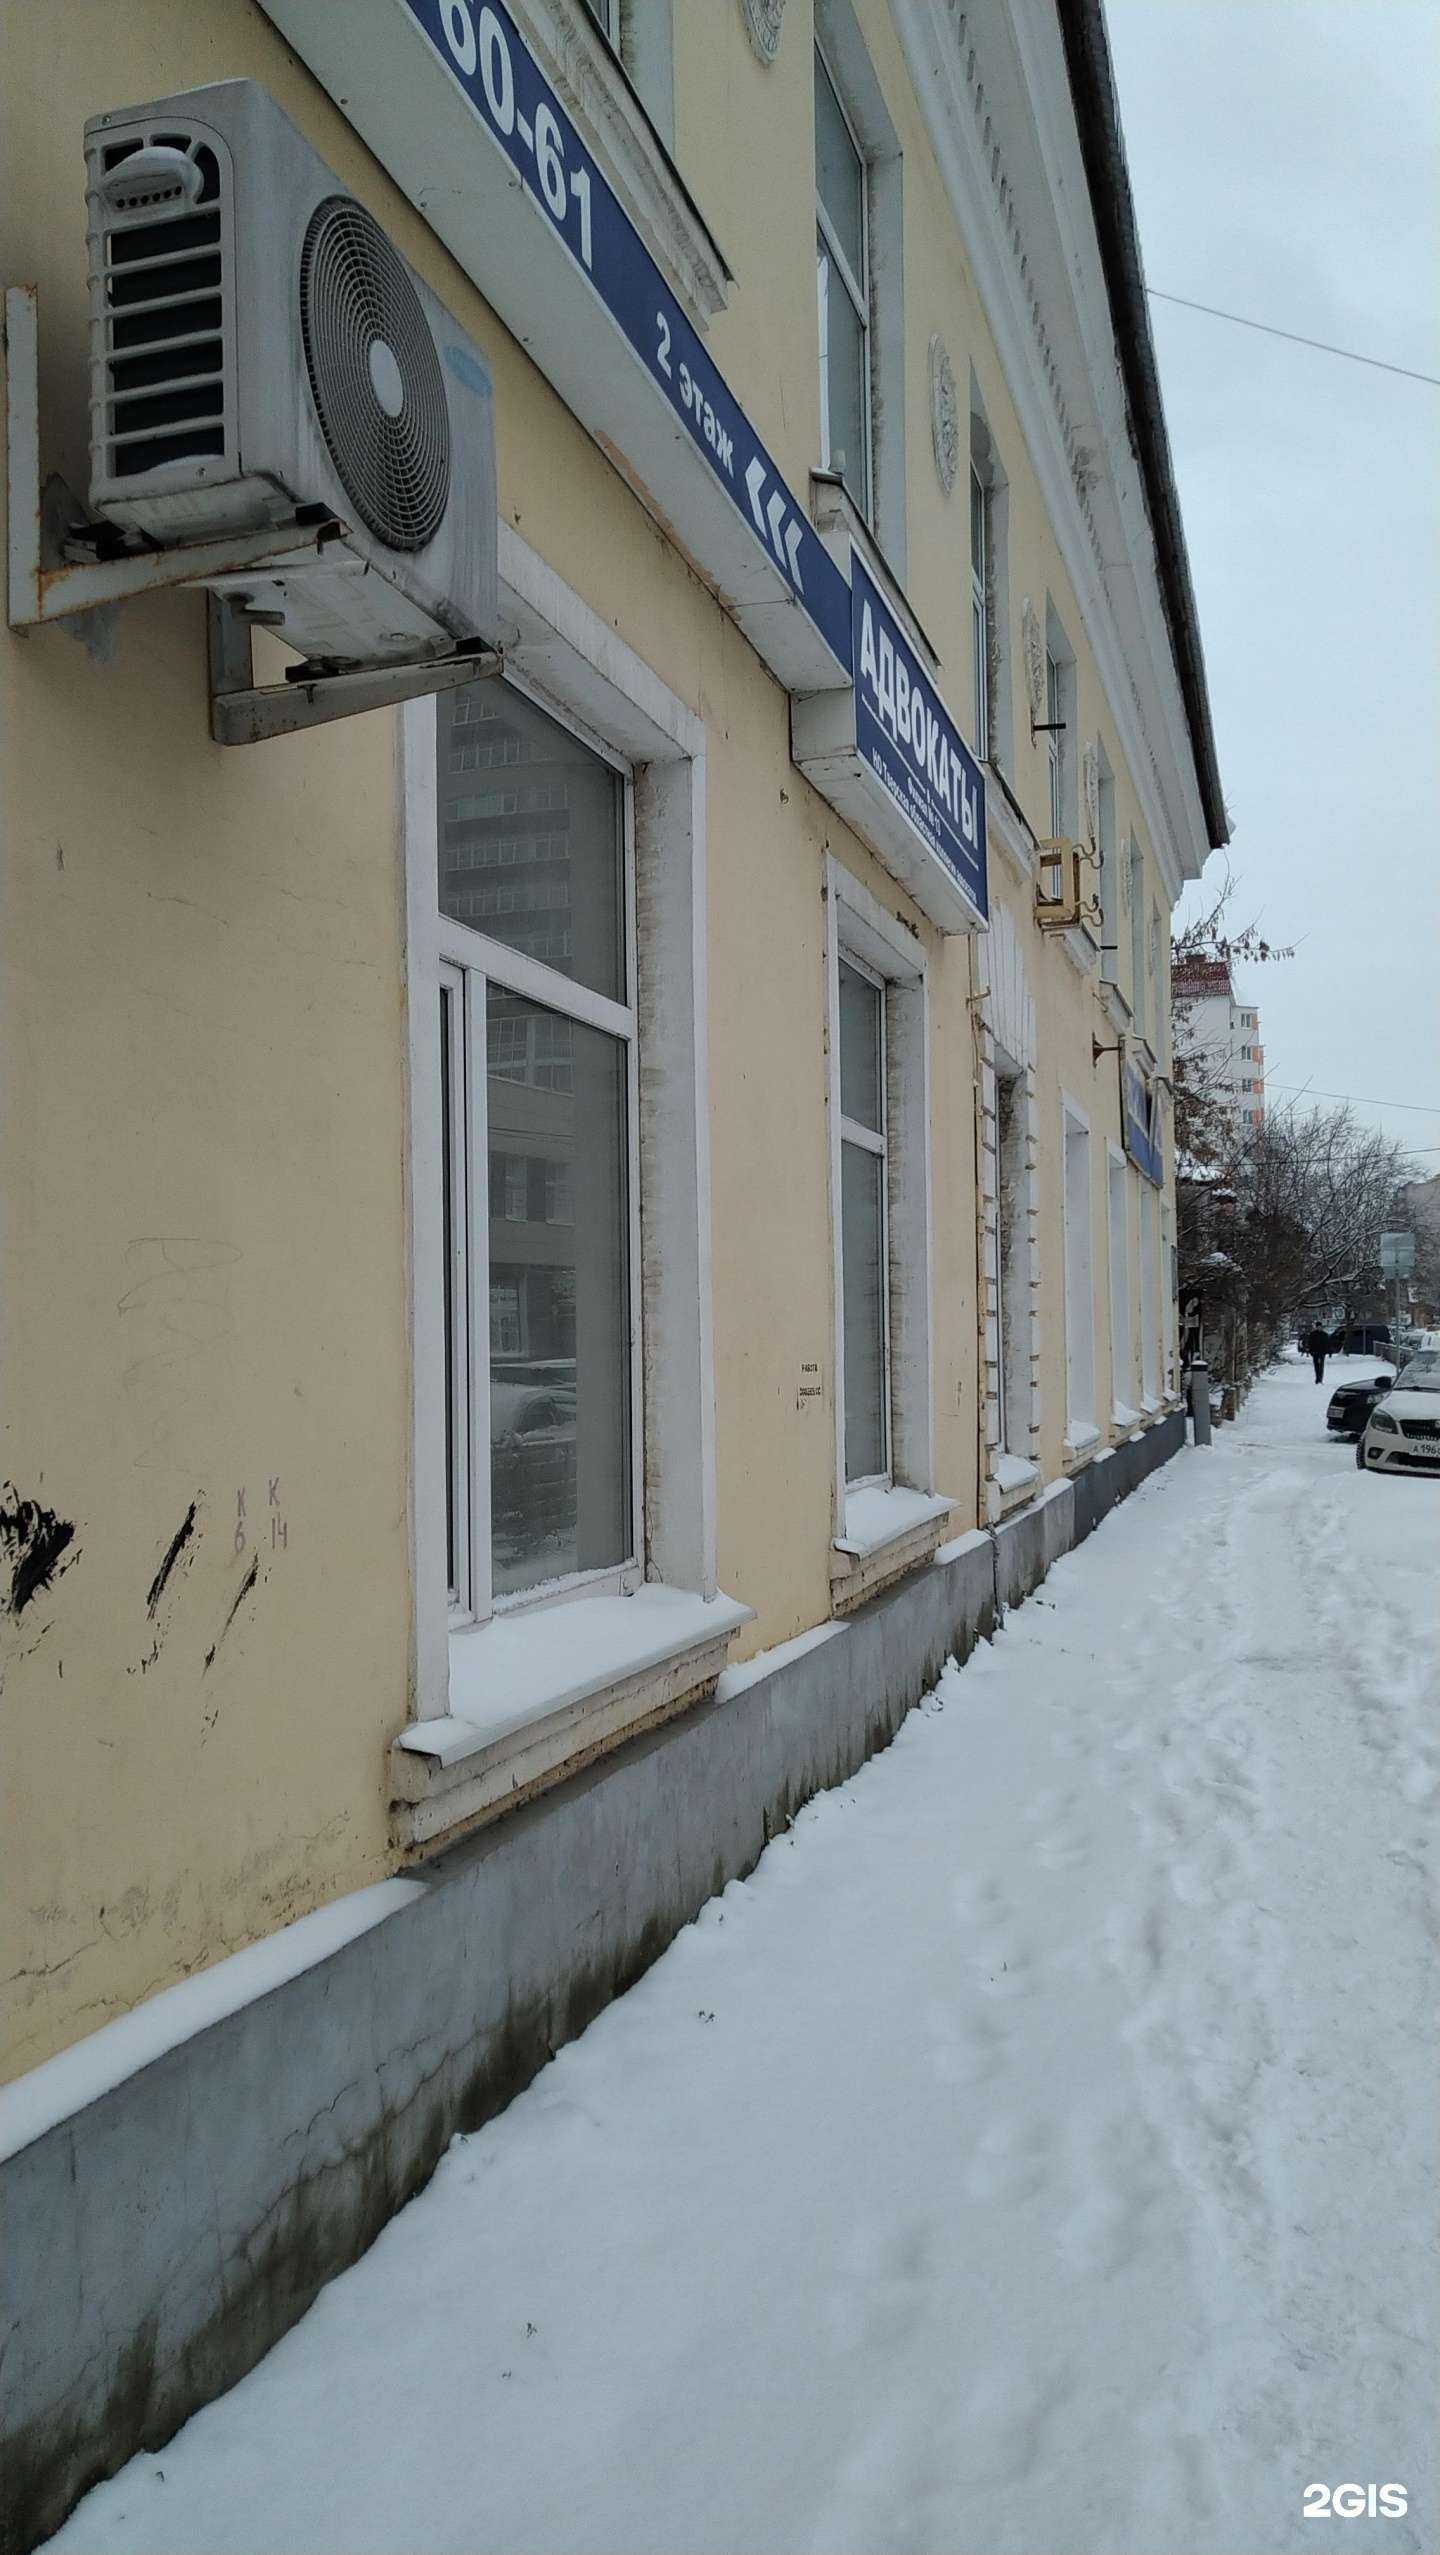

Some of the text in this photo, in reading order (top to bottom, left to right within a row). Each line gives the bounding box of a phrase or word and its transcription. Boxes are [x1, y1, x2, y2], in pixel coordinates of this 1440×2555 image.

[656, 311, 734, 479] 2 этаж
[860, 599, 978, 850] АДВОКАТЫ
[872, 747, 882, 775] НО
[234, 1520, 246, 1553] 6
